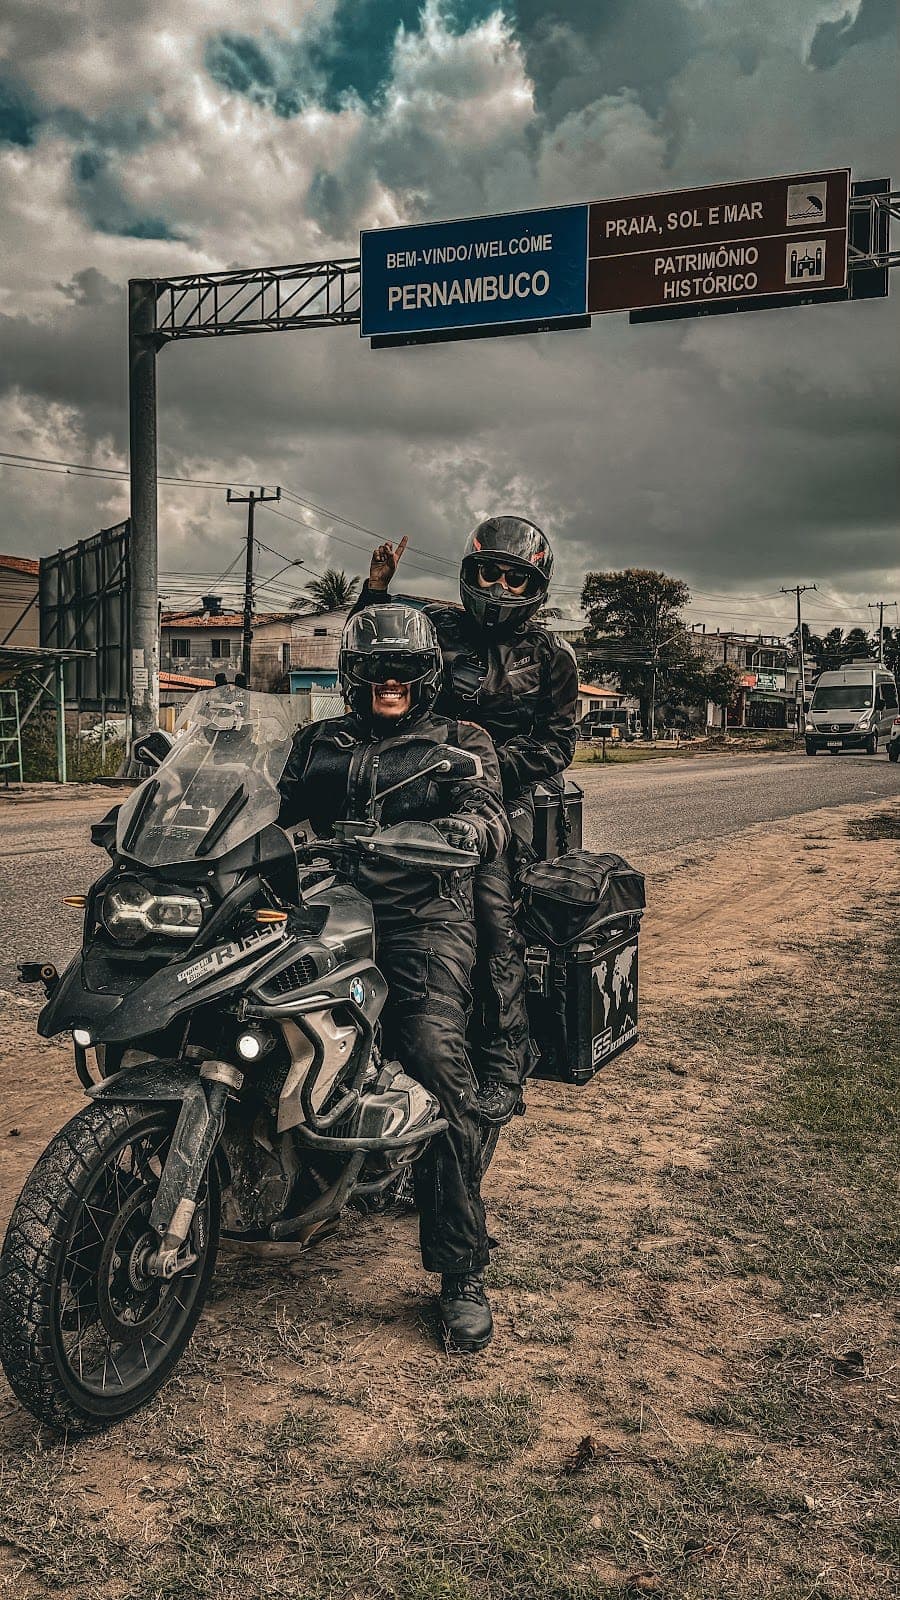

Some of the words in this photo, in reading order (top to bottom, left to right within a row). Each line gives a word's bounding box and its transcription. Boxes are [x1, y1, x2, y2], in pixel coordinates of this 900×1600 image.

[605, 215, 663, 237] PRAIA,
[667, 210, 703, 230] SOL
[708, 206, 720, 225] E
[723, 201, 764, 222] MAR
[386, 234, 553, 269] BEM-VINDO/WELCOME
[654, 246, 759, 276] PATRIMÔNIO
[388, 269, 550, 312] PERNAMBUCO
[663, 272, 758, 299] HISTÓRICO
